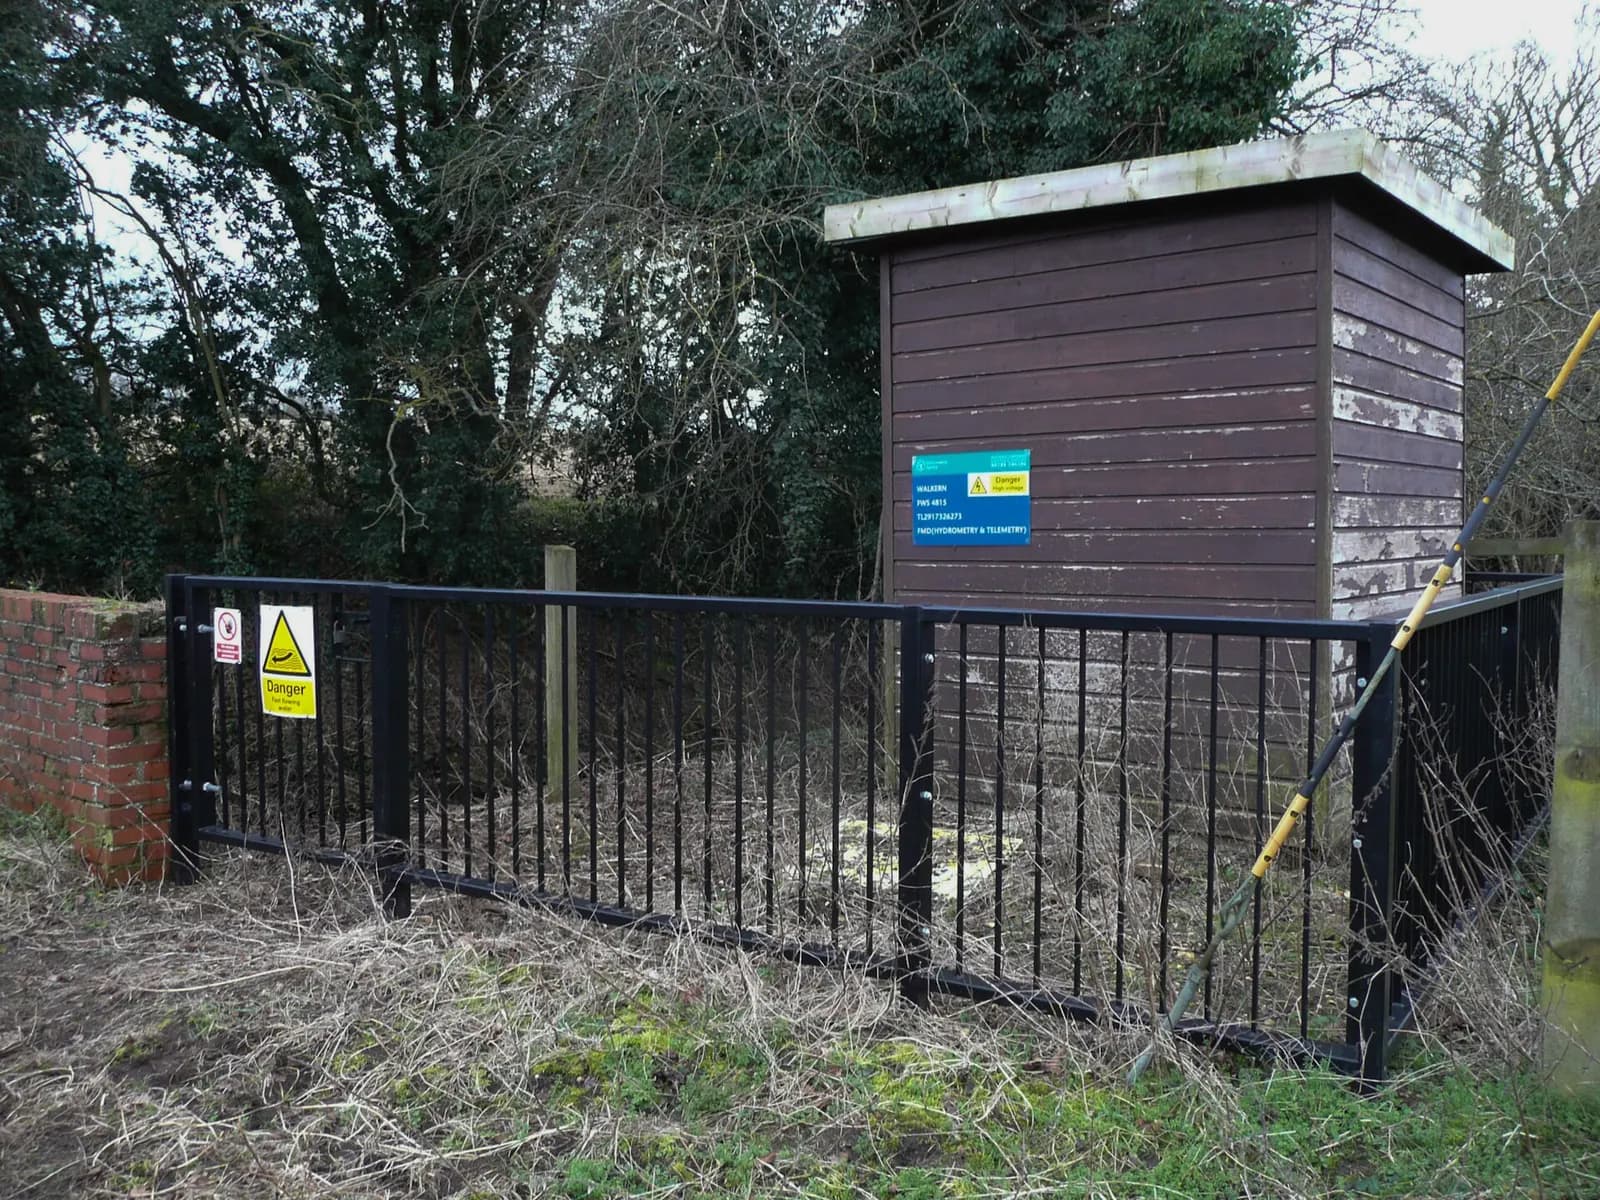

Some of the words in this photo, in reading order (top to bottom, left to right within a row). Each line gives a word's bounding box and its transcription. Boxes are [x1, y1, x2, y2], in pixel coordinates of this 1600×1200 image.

[995, 476, 1021, 484] Danger
[917, 484, 947, 493] WALKERN
[980, 526, 985, 534] &
[987, 525, 1027, 535] TELEMETRY)
[267, 679, 306, 697] Danger
